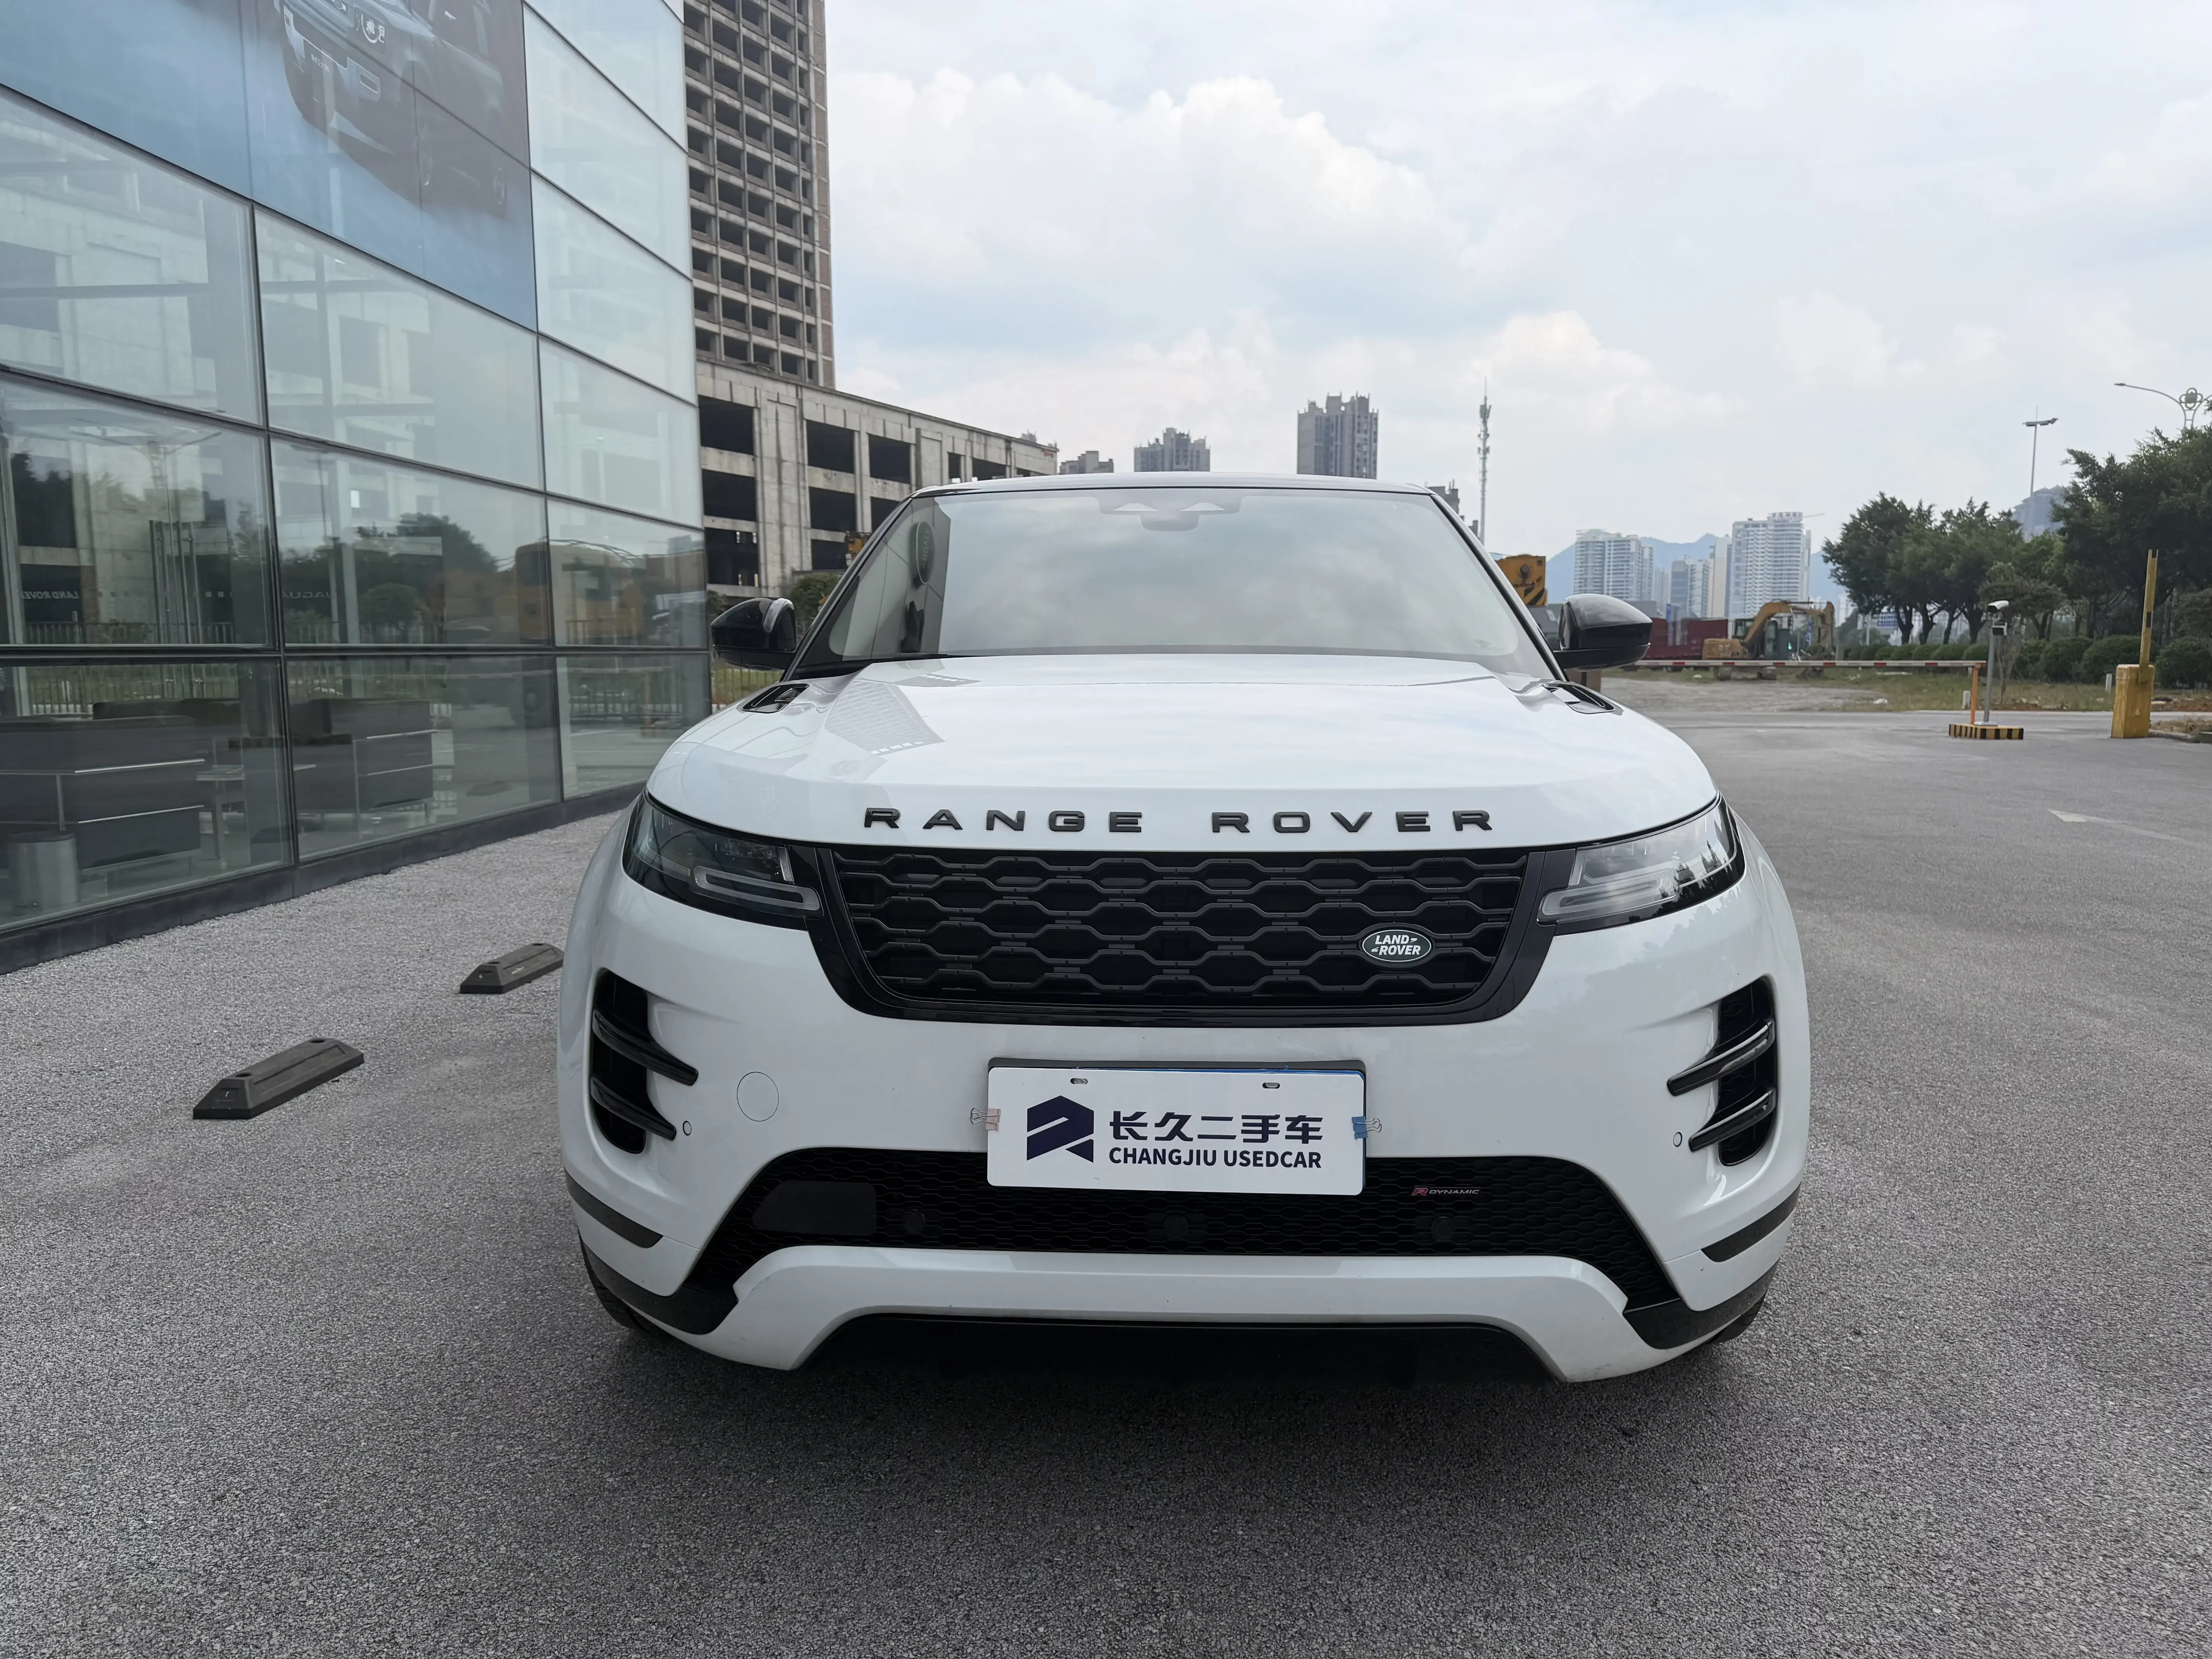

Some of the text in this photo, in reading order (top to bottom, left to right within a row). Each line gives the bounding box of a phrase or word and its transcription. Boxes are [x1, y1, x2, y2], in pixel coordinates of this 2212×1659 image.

[864, 808, 1492, 833] RANGE ROVER
[1375, 935, 1409, 945] LAND
[1379, 945, 1421, 955] ROVER
[1109, 1111, 1323, 1144] 长久二手车
[1109, 1146, 1322, 1168] CHANGJIU USEDCAR
